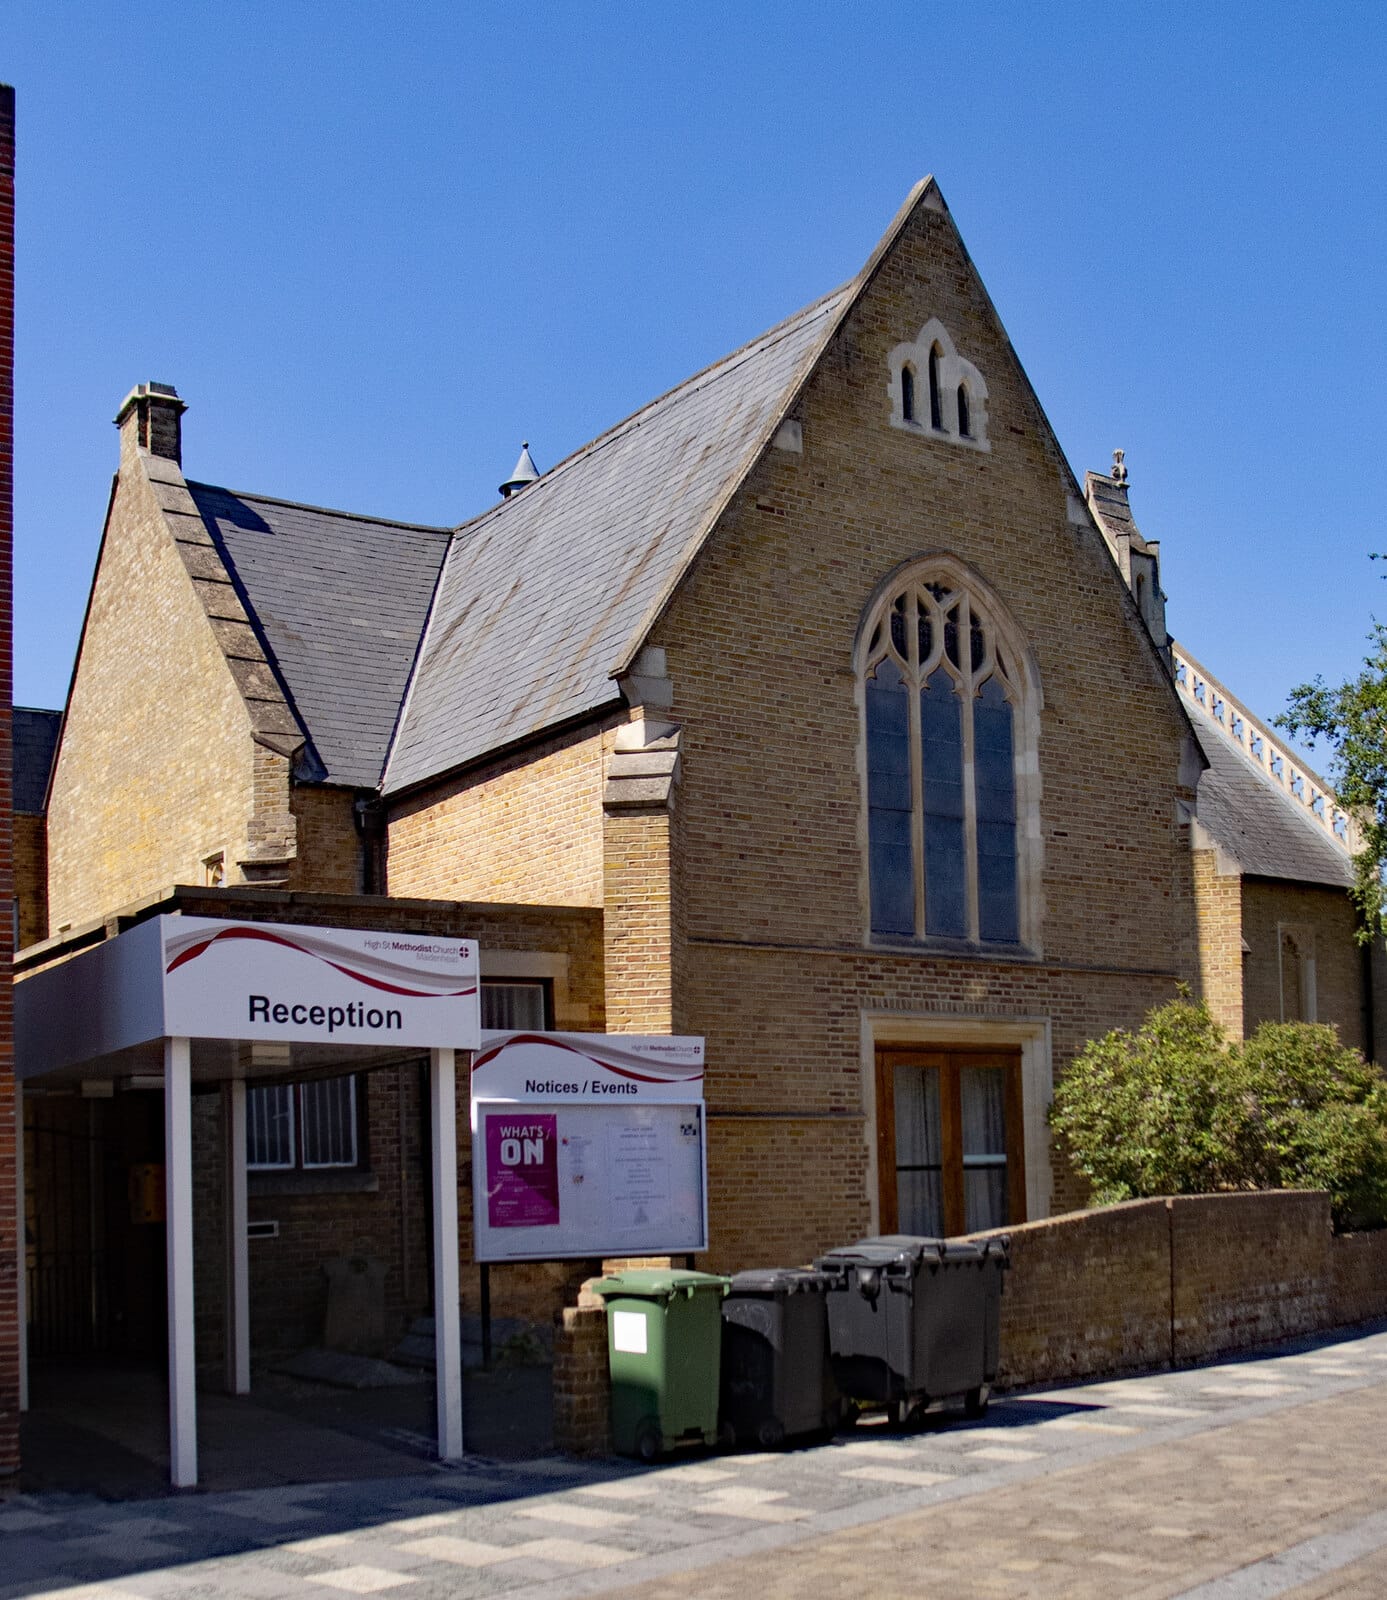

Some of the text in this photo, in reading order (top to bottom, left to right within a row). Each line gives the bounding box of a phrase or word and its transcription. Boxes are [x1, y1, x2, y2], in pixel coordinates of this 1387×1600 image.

[364, 940, 381, 951] High
[392, 942, 432, 953] Methodist
[433, 945, 458, 955] Church
[249, 995, 402, 1033] Reception
[525, 1080, 638, 1094] Notices / Events
[500, 1126, 544, 1138] WHAT'S
[501, 1138, 544, 1166] ON
